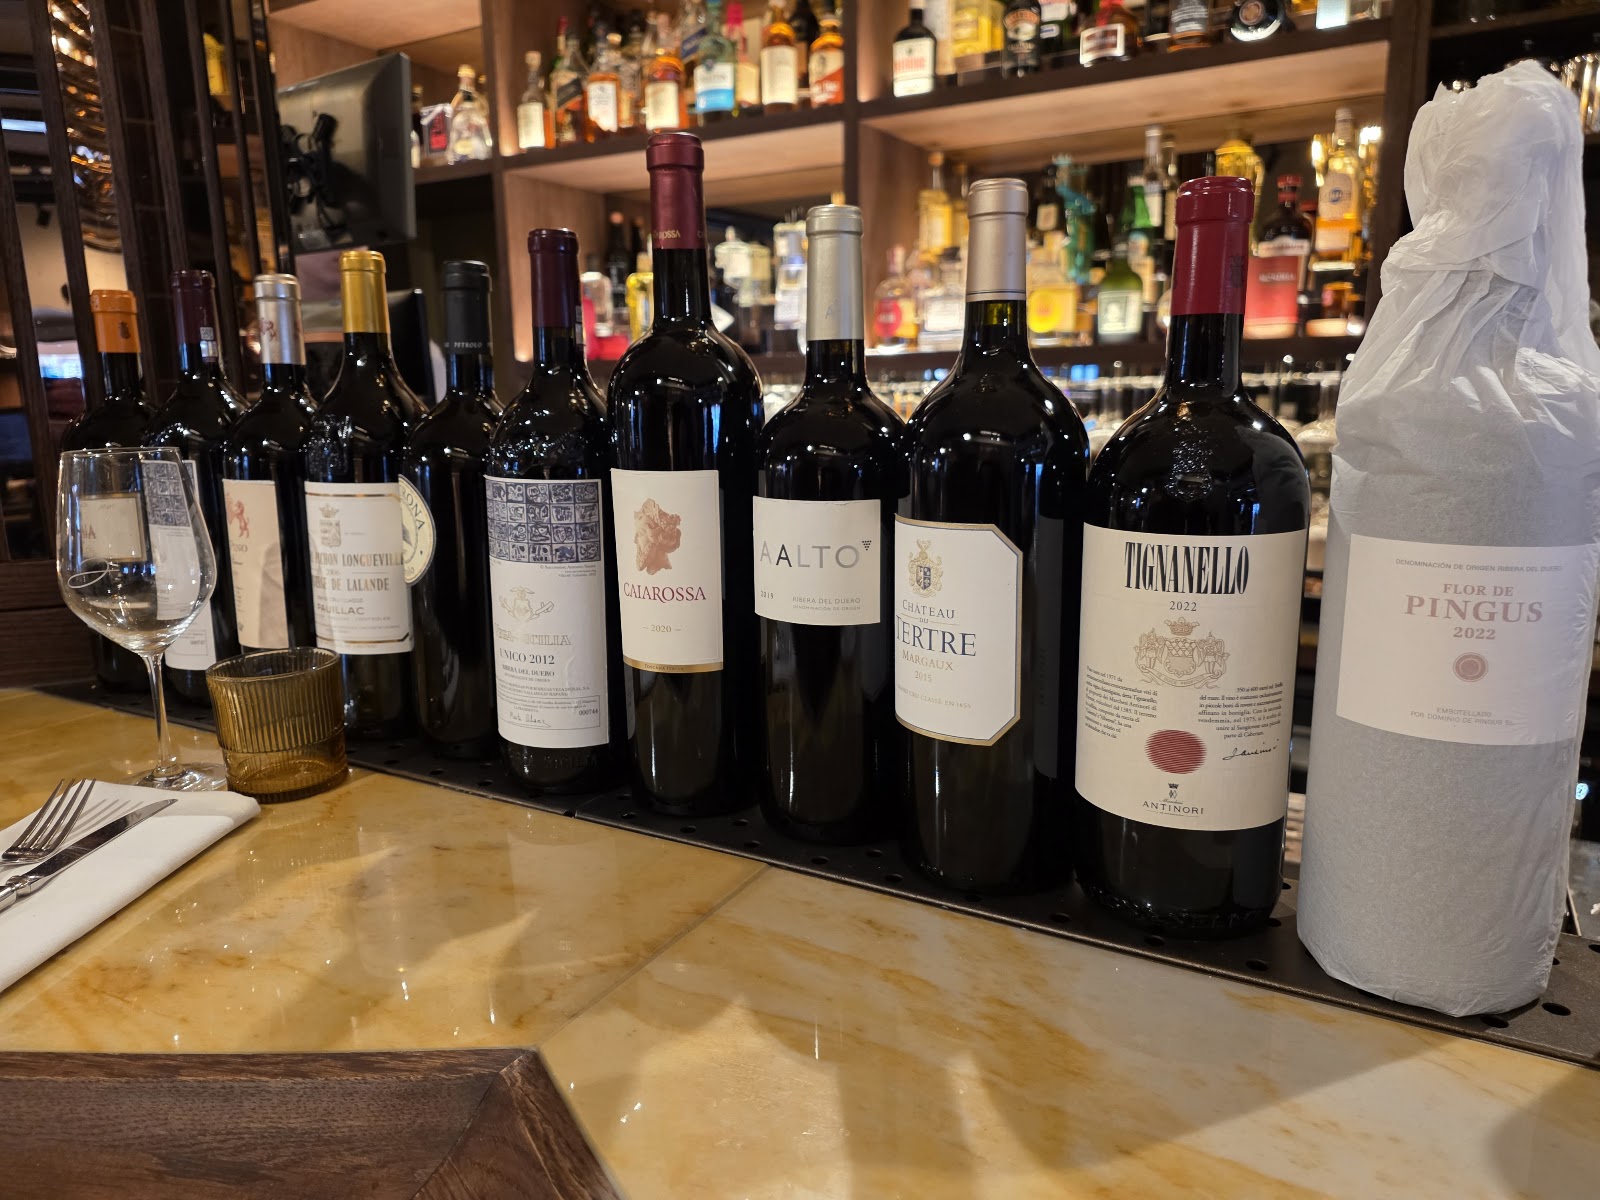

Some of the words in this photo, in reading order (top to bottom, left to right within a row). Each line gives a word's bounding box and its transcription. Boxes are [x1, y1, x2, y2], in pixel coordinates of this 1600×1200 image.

[759, 541, 860, 569] AALTO
[1124, 541, 1250, 595] TIGNANELLO
[1395, 558, 1451, 570] DENOMINACIÓN
[347, 578, 389, 592] LALANDE
[1443, 583, 1487, 596] FLOR
[1492, 585, 1514, 597] DE
[623, 582, 706, 603] CAIAROSSA
[792, 596, 816, 604] RIBERA
[1169, 600, 1197, 612] 2022
[1403, 594, 1543, 623] PINGUS
[651, 624, 672, 633] 2020
[895, 614, 977, 657] TERTRE
[1452, 626, 1496, 640] 2022
[529, 654, 555, 665] 2012
[902, 649, 954, 671] MARGAUX
[914, 671, 932, 683] 2015
[1410, 710, 1425, 718] POR
[1427, 713, 1461, 723] DOMINIO
[1474, 718, 1503, 726] PINGUS
[1436, 706, 1492, 718] EMBOTELLADO
[1142, 801, 1204, 815] ANTINORI
